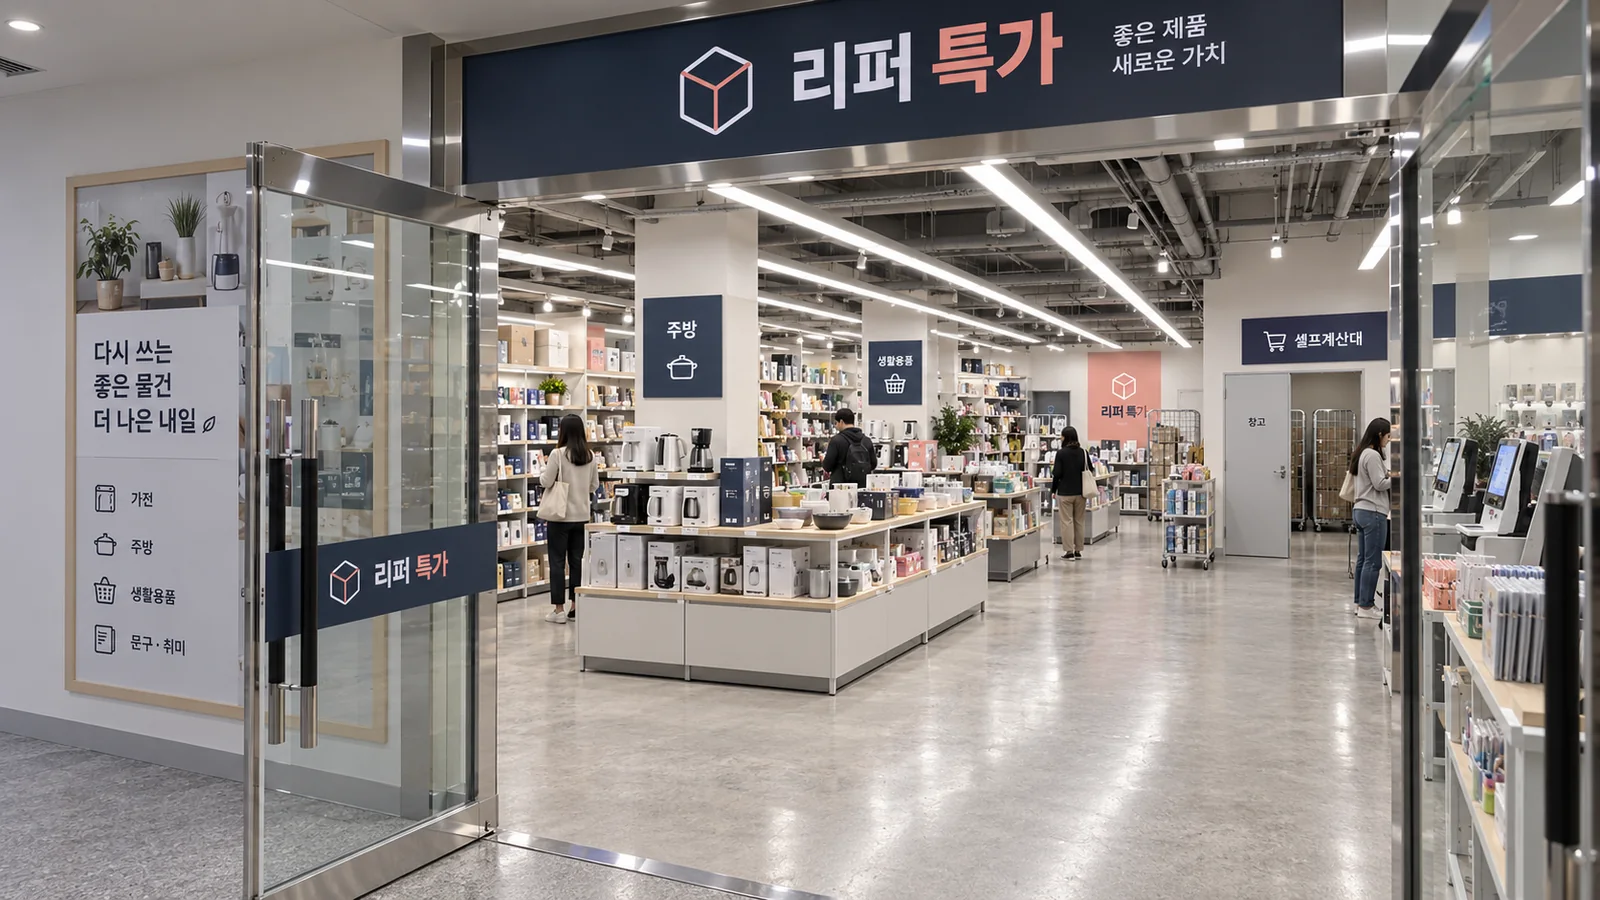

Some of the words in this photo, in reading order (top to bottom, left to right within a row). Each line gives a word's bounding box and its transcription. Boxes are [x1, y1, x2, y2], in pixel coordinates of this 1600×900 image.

[1113, 22, 1155, 46] 좋은
[1163, 14, 1207, 38] 제품
[794, 32, 911, 109] 리퍼
[932, 12, 1063, 93] 특가
[1113, 49, 1175, 75] 새로운
[1183, 41, 1224, 67] 가치
[667, 320, 697, 339] 주방
[1295, 331, 1362, 348] 셀프계산대
[95, 340, 128, 365] 다시
[136, 340, 172, 363] 쓰는
[94, 374, 129, 398] 좋은
[136, 373, 171, 398] 물건
[95, 408, 109, 433] 더
[118, 408, 153, 433] 나은
[160, 408, 195, 433] 내일
[1102, 405, 1123, 418] 리퍼
[1126, 405, 1148, 418] 특가
[1248, 417, 1266, 428] 창고
[131, 492, 153, 508] 가전
[131, 540, 153, 555] 주방
[375, 557, 409, 588] 리퍼
[415, 550, 449, 580] 특가
[131, 587, 175, 605] 생활용품
[131, 635, 153, 651] 문구
[164, 639, 185, 656] 취미
